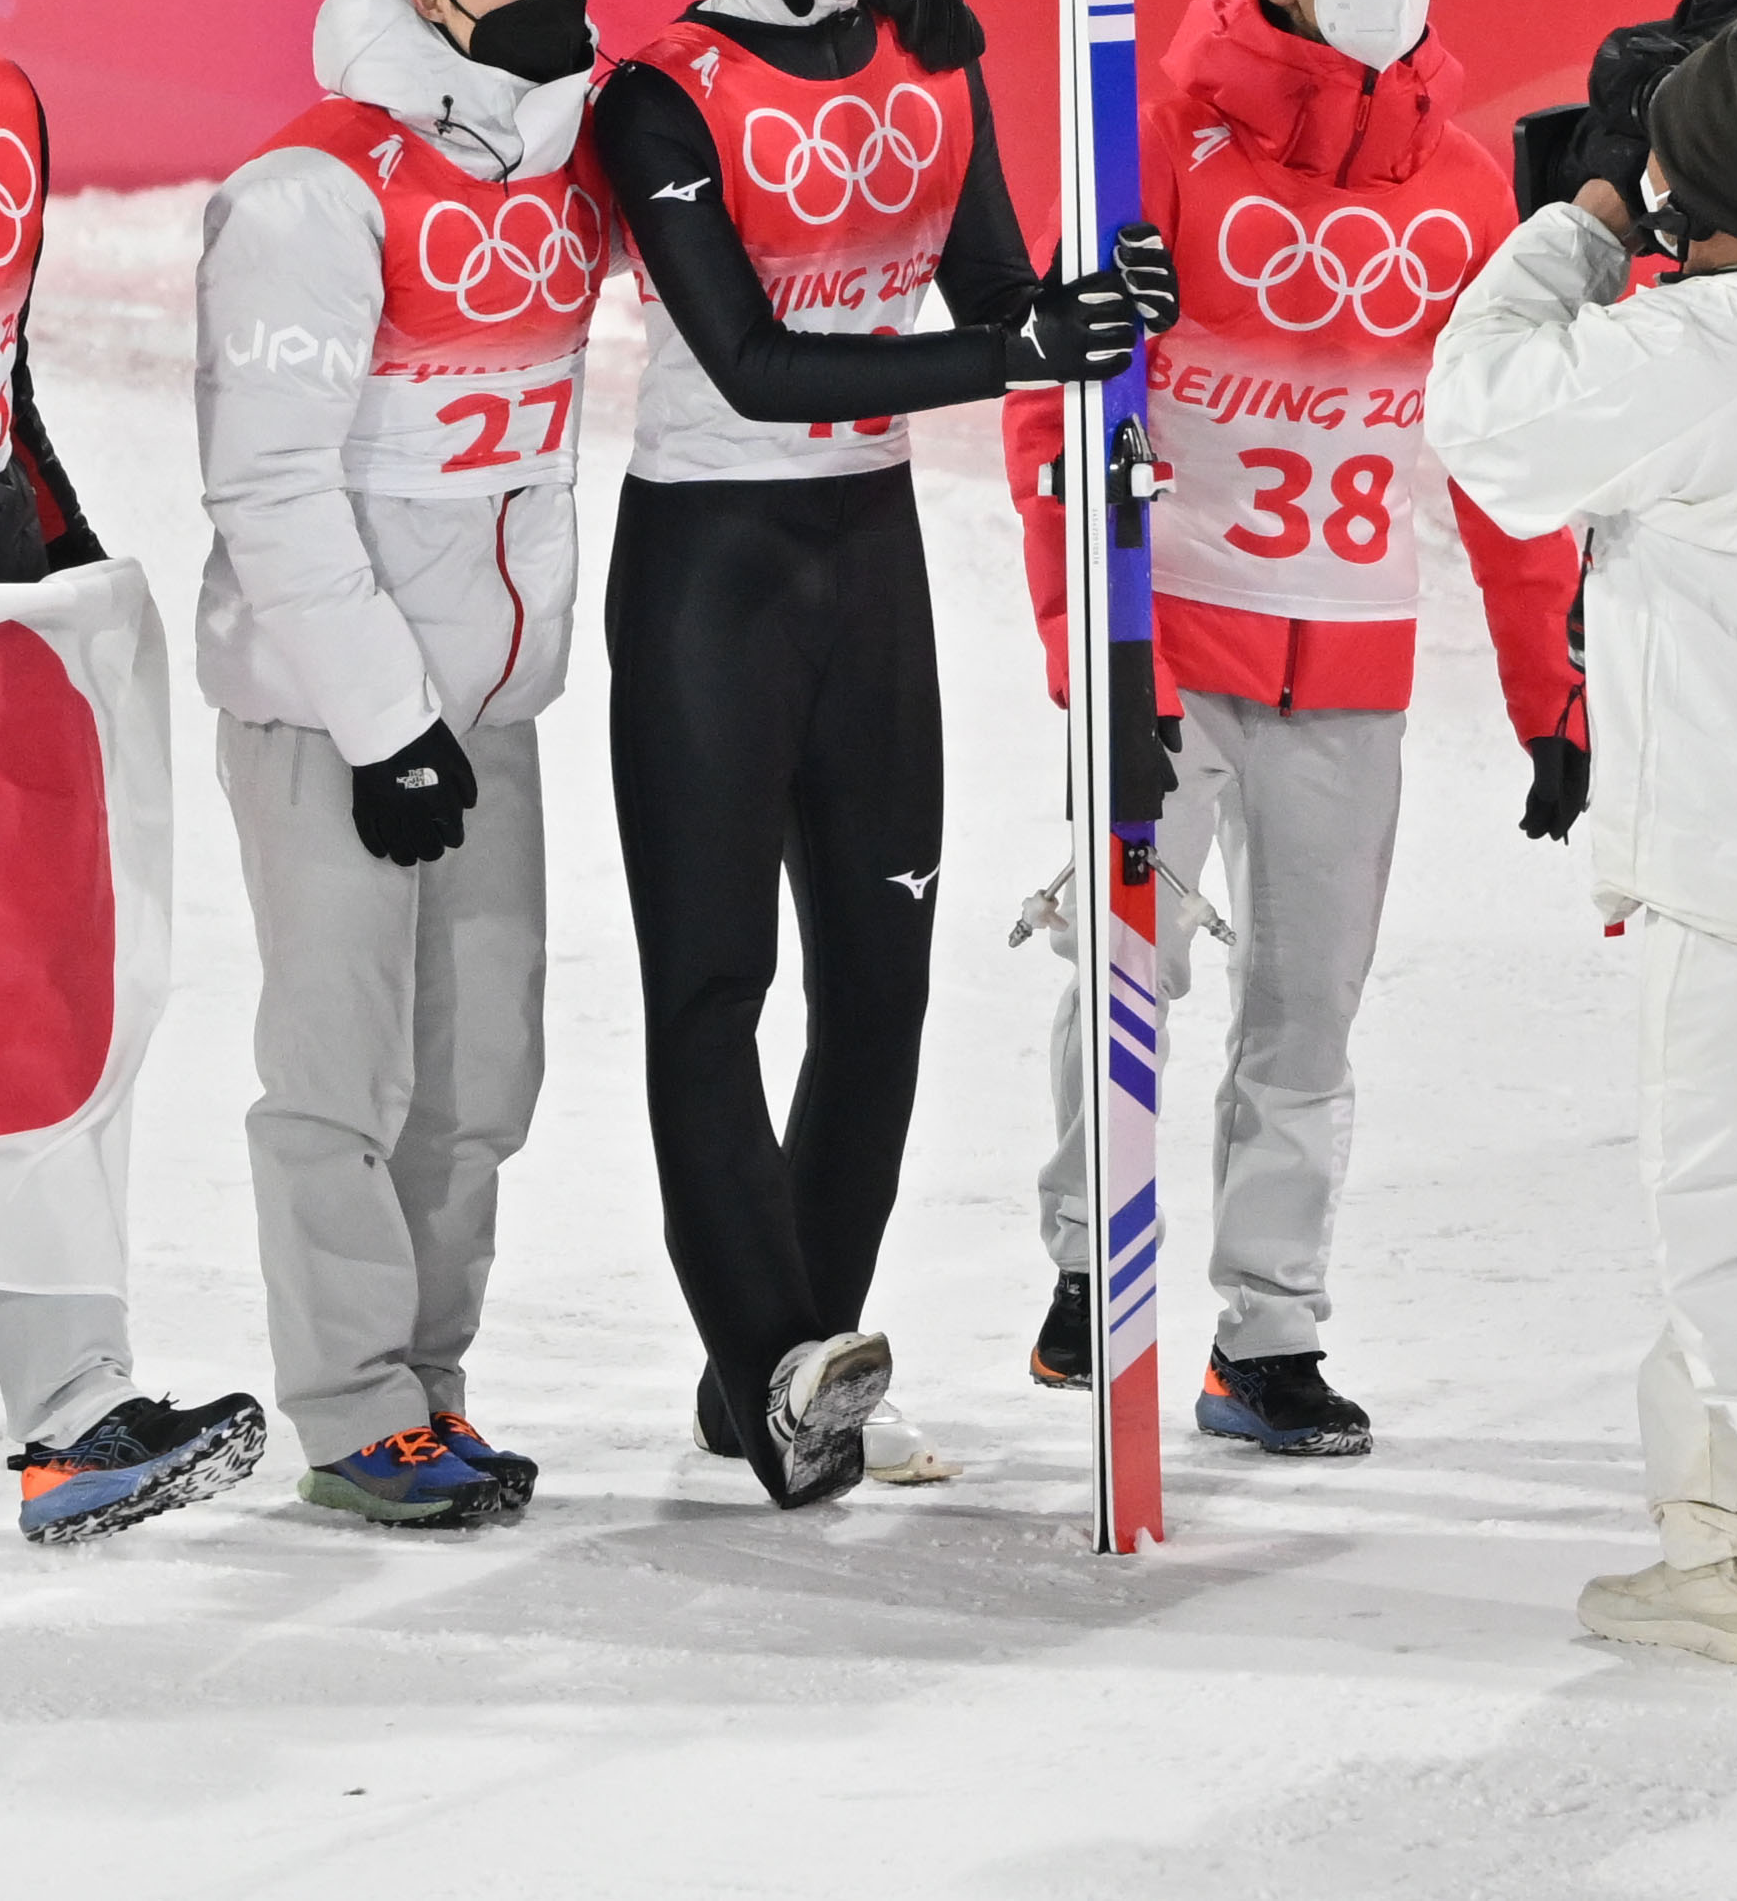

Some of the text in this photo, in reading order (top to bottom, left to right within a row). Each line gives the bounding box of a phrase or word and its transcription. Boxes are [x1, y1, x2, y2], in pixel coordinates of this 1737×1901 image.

[224, 318, 369, 381] JPN
[1146, 350, 1349, 431] BEIJING
[435, 377, 574, 474] 27
[1223, 447, 1395, 565] 38
